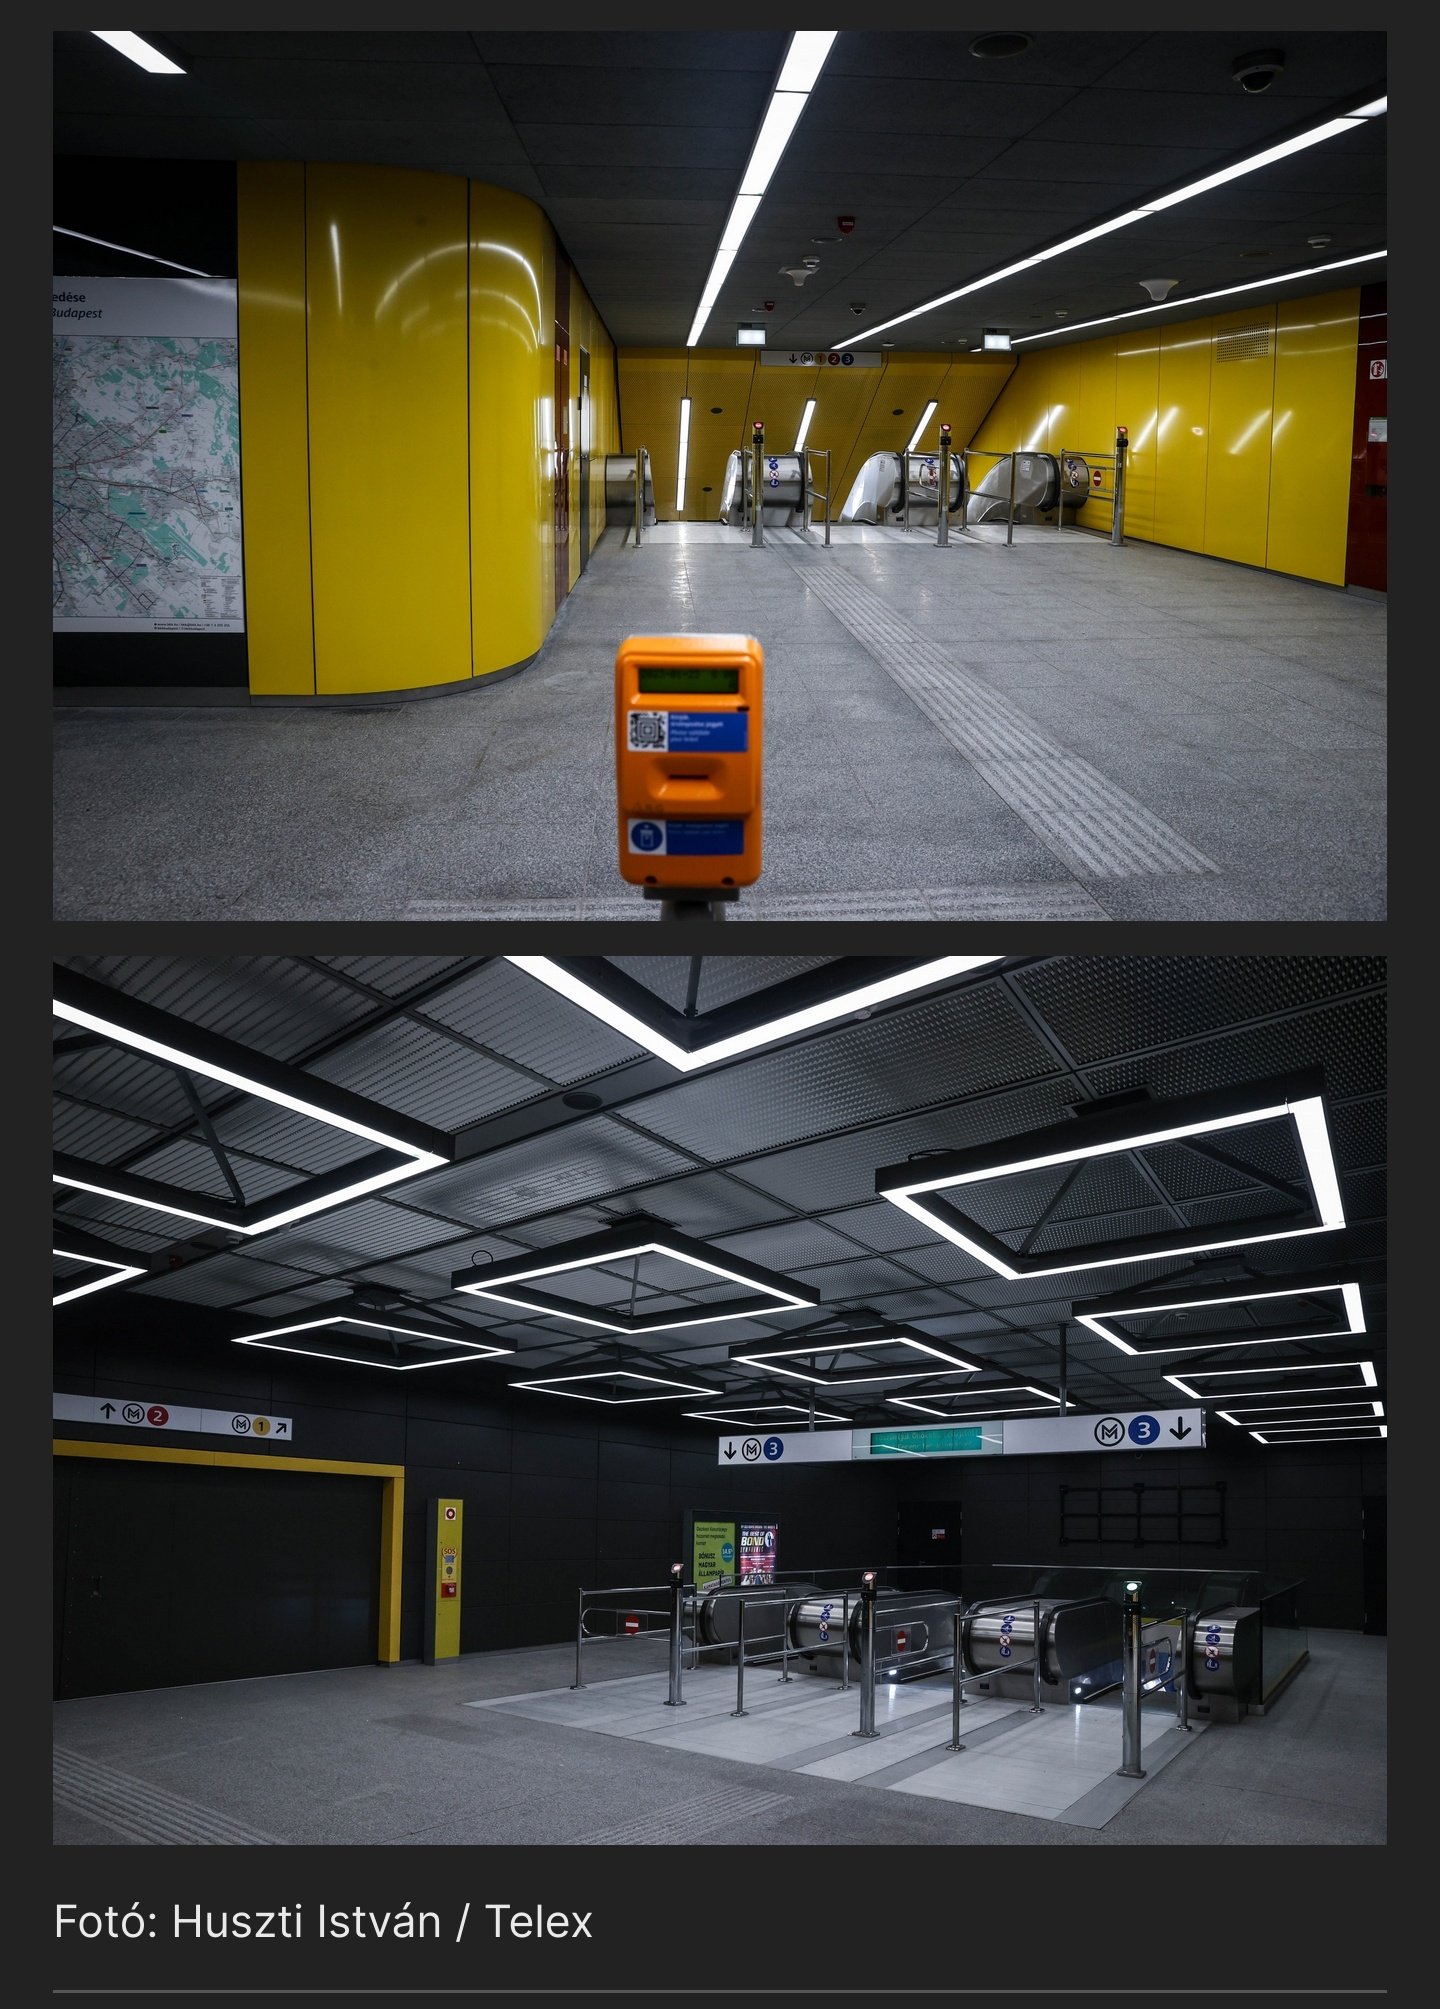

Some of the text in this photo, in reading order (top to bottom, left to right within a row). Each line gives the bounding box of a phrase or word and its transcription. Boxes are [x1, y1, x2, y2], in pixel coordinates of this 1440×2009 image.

[154, 1410, 162, 1422] 2
[1138, 1422, 1151, 1439] 3
[769, 1442, 778, 1455] 3
[741, 1537, 764, 1546] BOND
